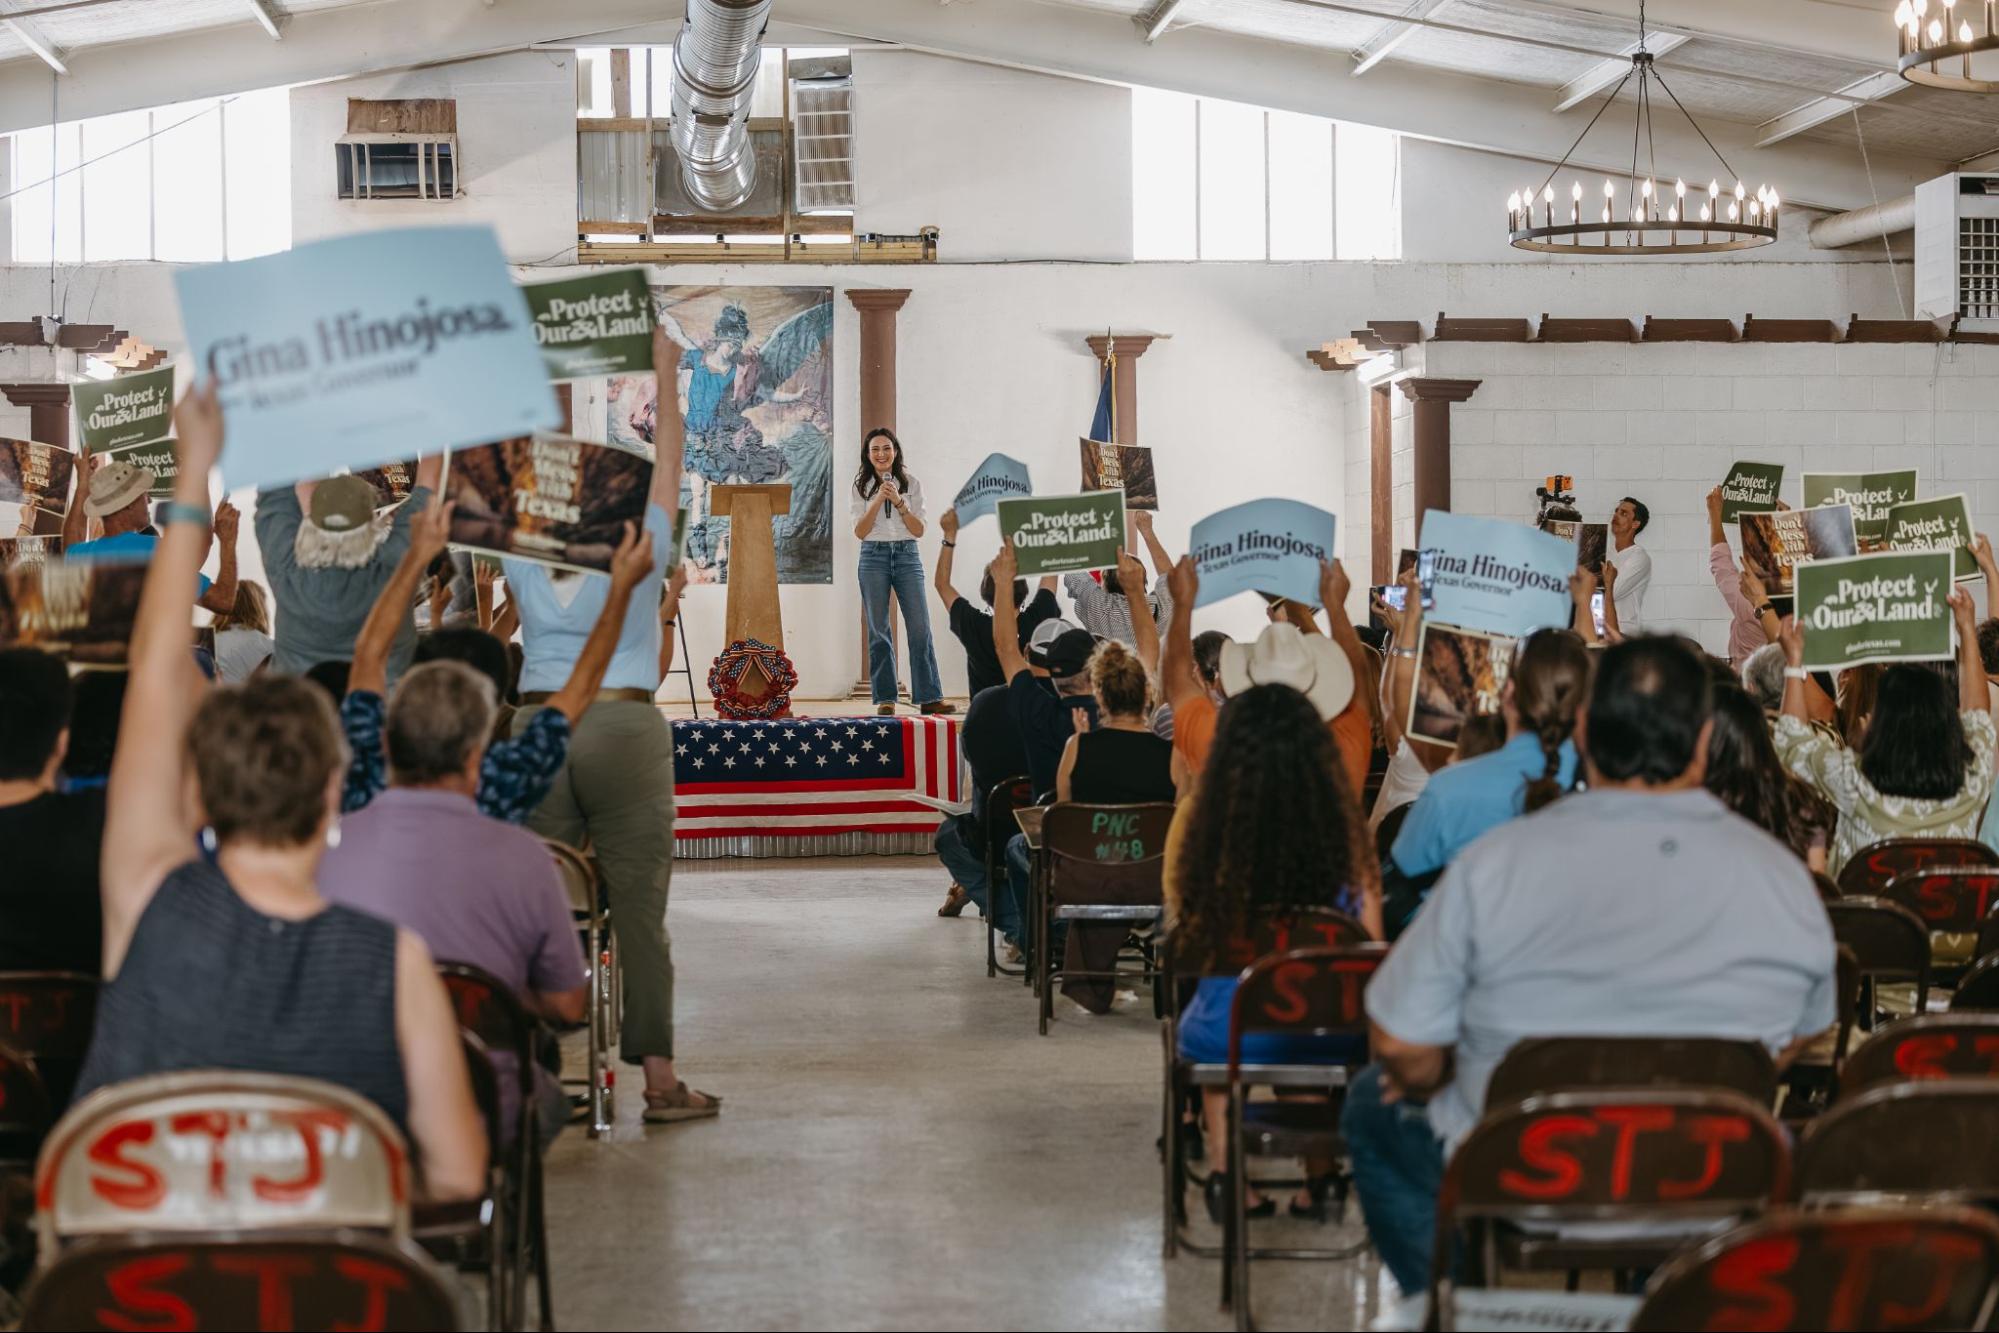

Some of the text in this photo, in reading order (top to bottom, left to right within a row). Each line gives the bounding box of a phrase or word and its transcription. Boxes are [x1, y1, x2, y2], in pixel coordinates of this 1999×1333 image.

[549, 289, 633, 321] Protect
[530, 310, 649, 345] Our Land
[207, 296, 515, 386] Gina Hinojosa
[103, 385, 155, 411] Protect
[89, 398, 163, 430] Our Land
[129, 451, 174, 466] Protect
[1100, 447, 1119, 458] Don't
[23, 471, 50, 487] Texas
[157, 464, 178, 477] Lan
[384, 473, 410, 484] Texas
[1098, 474, 1125, 488] Texas
[1734, 472, 1768, 490] Protect
[977, 474, 1029, 493] Hinojosa
[1722, 485, 1773, 504] Our Land
[1833, 486, 1893, 504] Protect
[514, 487, 582, 524] Texas
[1031, 508, 1098, 530] Protect
[1774, 515, 1802, 530] Don't
[1899, 514, 1947, 539] Protect
[1013, 521, 1111, 548] Our Land
[1237, 529, 1327, 560] Hinojosa
[1776, 529, 1806, 541] Mess
[1203, 551, 1281, 575] Texas Governor
[1461, 577, 1513, 597] Governor
[1838, 573, 1917, 604] Protect
[1813, 594, 1933, 630] Our Land
[1092, 812, 1140, 837] PNC
[86, 1108, 352, 1210] STJ
[1500, 1104, 1751, 1199] STJ
[1703, 1222, 1982, 1332] STJ
[96, 1252, 409, 1332] STJ
